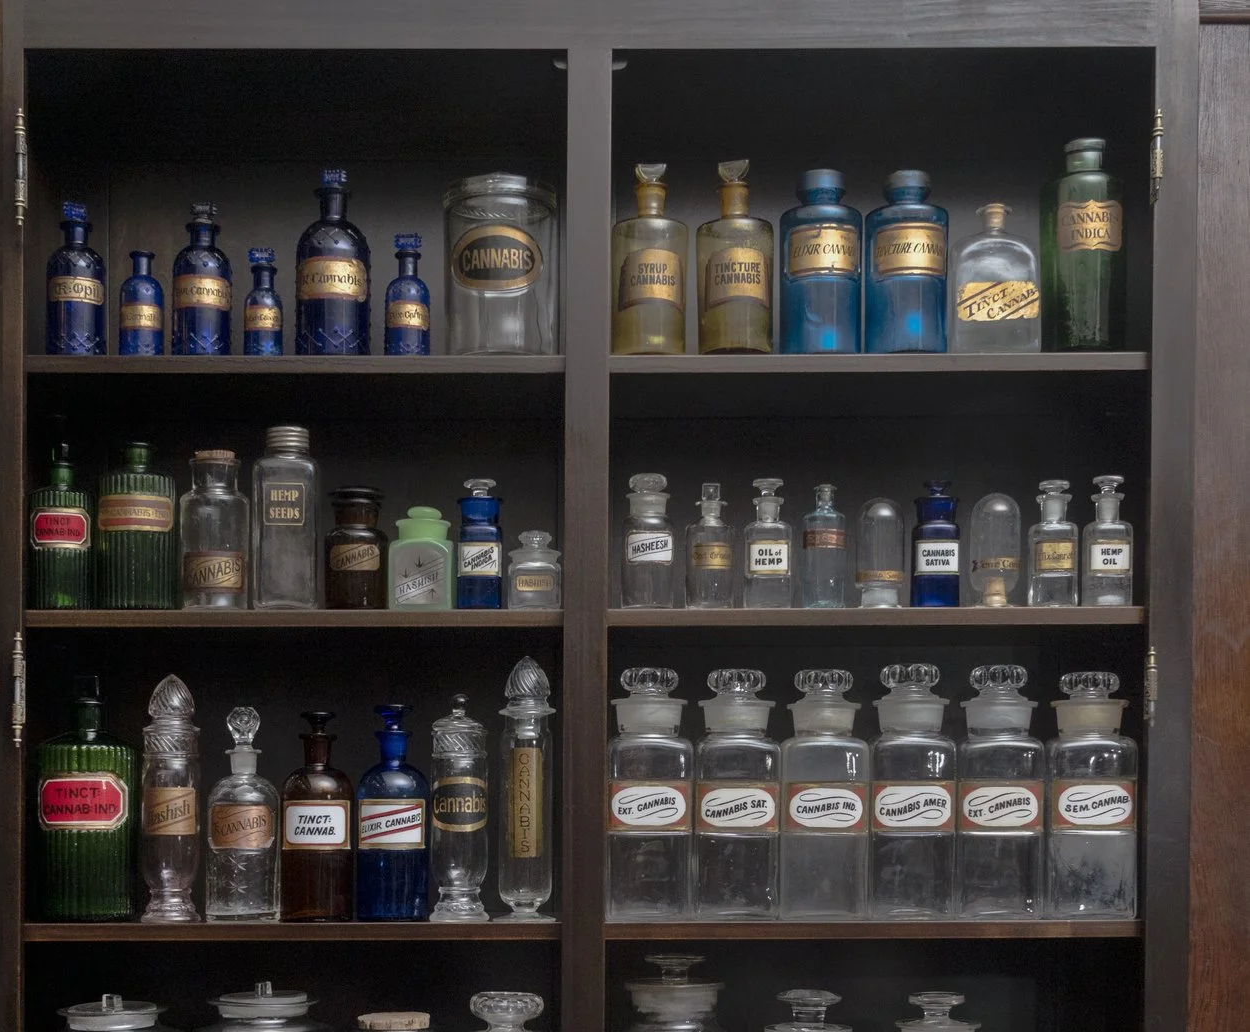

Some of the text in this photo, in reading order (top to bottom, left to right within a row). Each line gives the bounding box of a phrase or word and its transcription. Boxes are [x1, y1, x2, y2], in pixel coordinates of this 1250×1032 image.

[1061, 211, 1119, 225] CANNABIS
[1072, 228, 1111, 240] INDICA
[792, 243, 821, 257] ELIXIR
[462, 248, 533, 272] CANNABIS
[638, 263, 668, 274] SYRUP
[714, 262, 761, 274] TINCTURE
[630, 275, 676, 286] CANNABIS
[714, 273, 761, 284] CANNABIS
[270, 489, 299, 501] HEMP
[269, 507, 300, 519] SEEDS
[631, 539, 669, 555] HASHEESH
[758, 548, 782, 557] OIL of
[922, 549, 955, 558] CANNABIS
[1101, 548, 1123, 556] HEMP
[336, 545, 376, 568] CANNABIS
[463, 547, 494, 568] CANNABIS
[471, 554, 493, 570] INDICA
[754, 558, 783, 566] HEMP
[925, 558, 950, 567] SATIVA
[1102, 558, 1118, 566] OIL
[186, 558, 241, 585] CANNABIS
[398, 572, 439, 595] HASHISH
[517, 578, 553, 587] HASHISH
[433, 793, 487, 814] Cannabis
[518, 753, 531, 854] CANNABIS
[617, 796, 676, 815] EXT. CANNABIS
[705, 799, 768, 818] CANNABIS SAT.
[796, 801, 857, 814] CANNABIS IND.
[879, 802, 921, 817] CANNABIS
[968, 797, 1031, 818] EXT. CANNABIS
[1064, 795, 1130, 813] SEM. CANNAB.
[221, 813, 267, 836] CANNABIS
[297, 815, 332, 824] TINCT:
[361, 813, 421, 834] ELIXIR CANNABIS
[294, 826, 336, 837] CANNAB.
